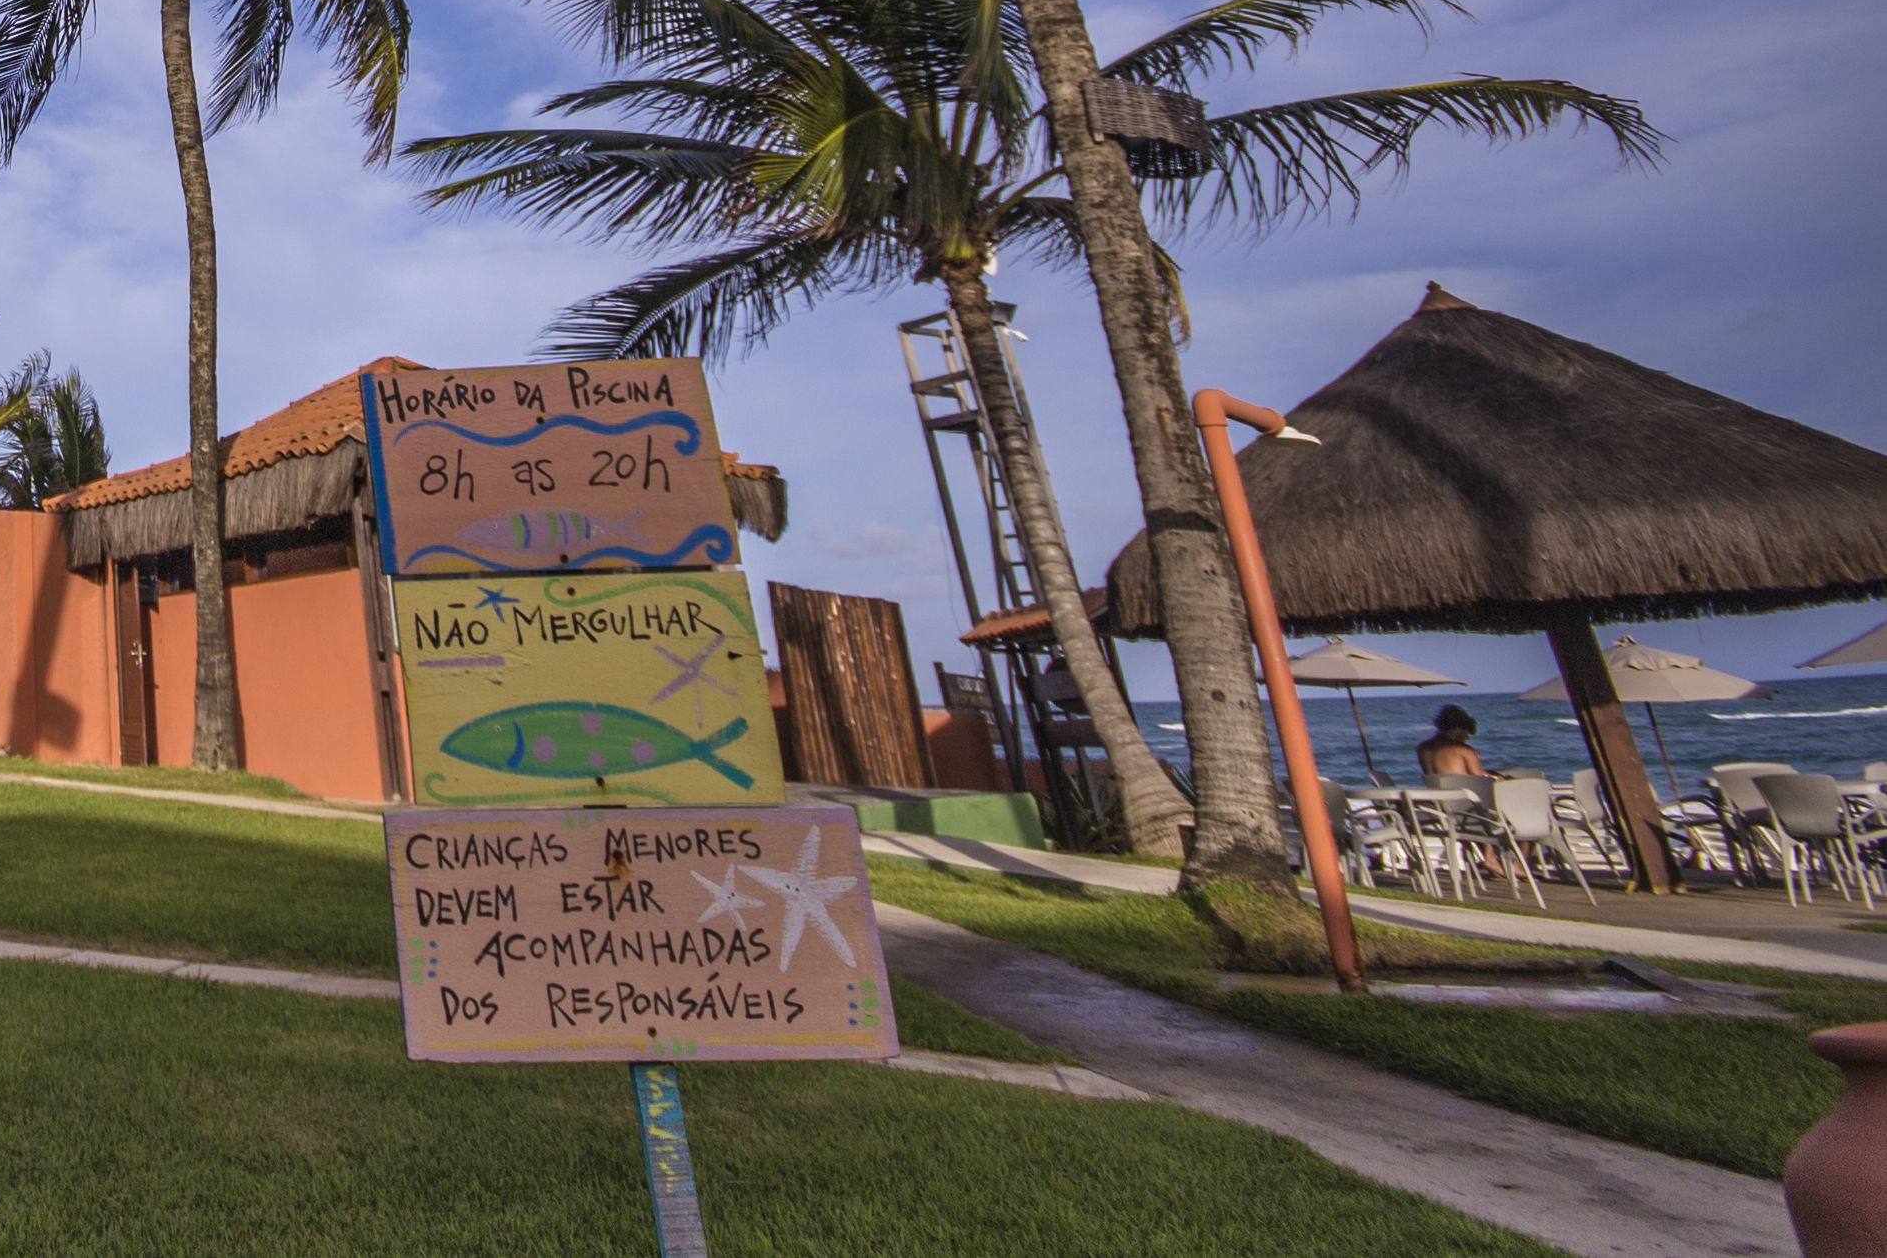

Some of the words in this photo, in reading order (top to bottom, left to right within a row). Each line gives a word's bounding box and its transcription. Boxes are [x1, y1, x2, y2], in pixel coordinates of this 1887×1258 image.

[419, 448, 475, 502] 8h
[588, 435, 671, 493] 20h
[414, 602, 489, 651] NÃO
[513, 600, 724, 647] MERGULHAR
[405, 832, 568, 870] CRIANÇAS
[604, 827, 762, 866] MENORES
[415, 883, 518, 927] DEVEM
[560, 875, 665, 922] ESTAR
[474, 927, 771, 978] ACOMPANHADAS
[440, 985, 499, 1025] DOS
[546, 971, 805, 1029] RESPONSÁVEIS
